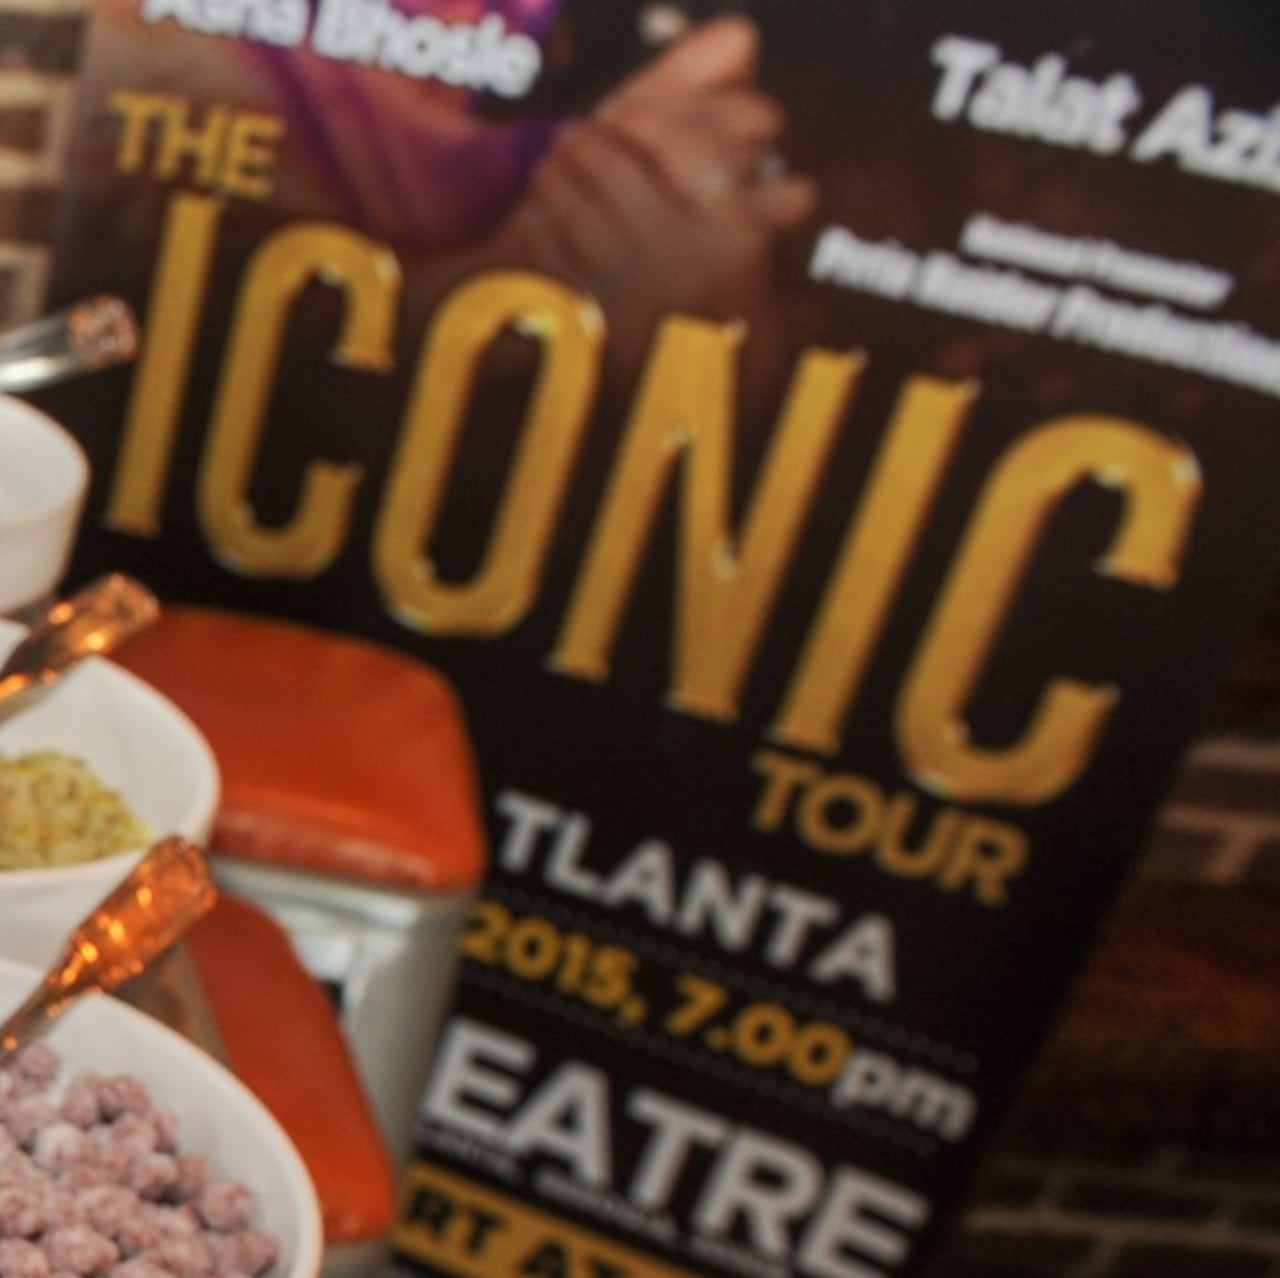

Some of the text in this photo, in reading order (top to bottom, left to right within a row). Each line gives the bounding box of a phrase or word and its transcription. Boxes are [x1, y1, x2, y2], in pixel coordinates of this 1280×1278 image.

[110, 90, 284, 200] THE
[930, 33, 1142, 155] Talat
[104, 195, 1204, 804] ICONIC
[495, 790, 897, 1000] TLANTA
[752, 752, 1028, 905] TOUR
[665, 974, 980, 1142] 7.00pm
